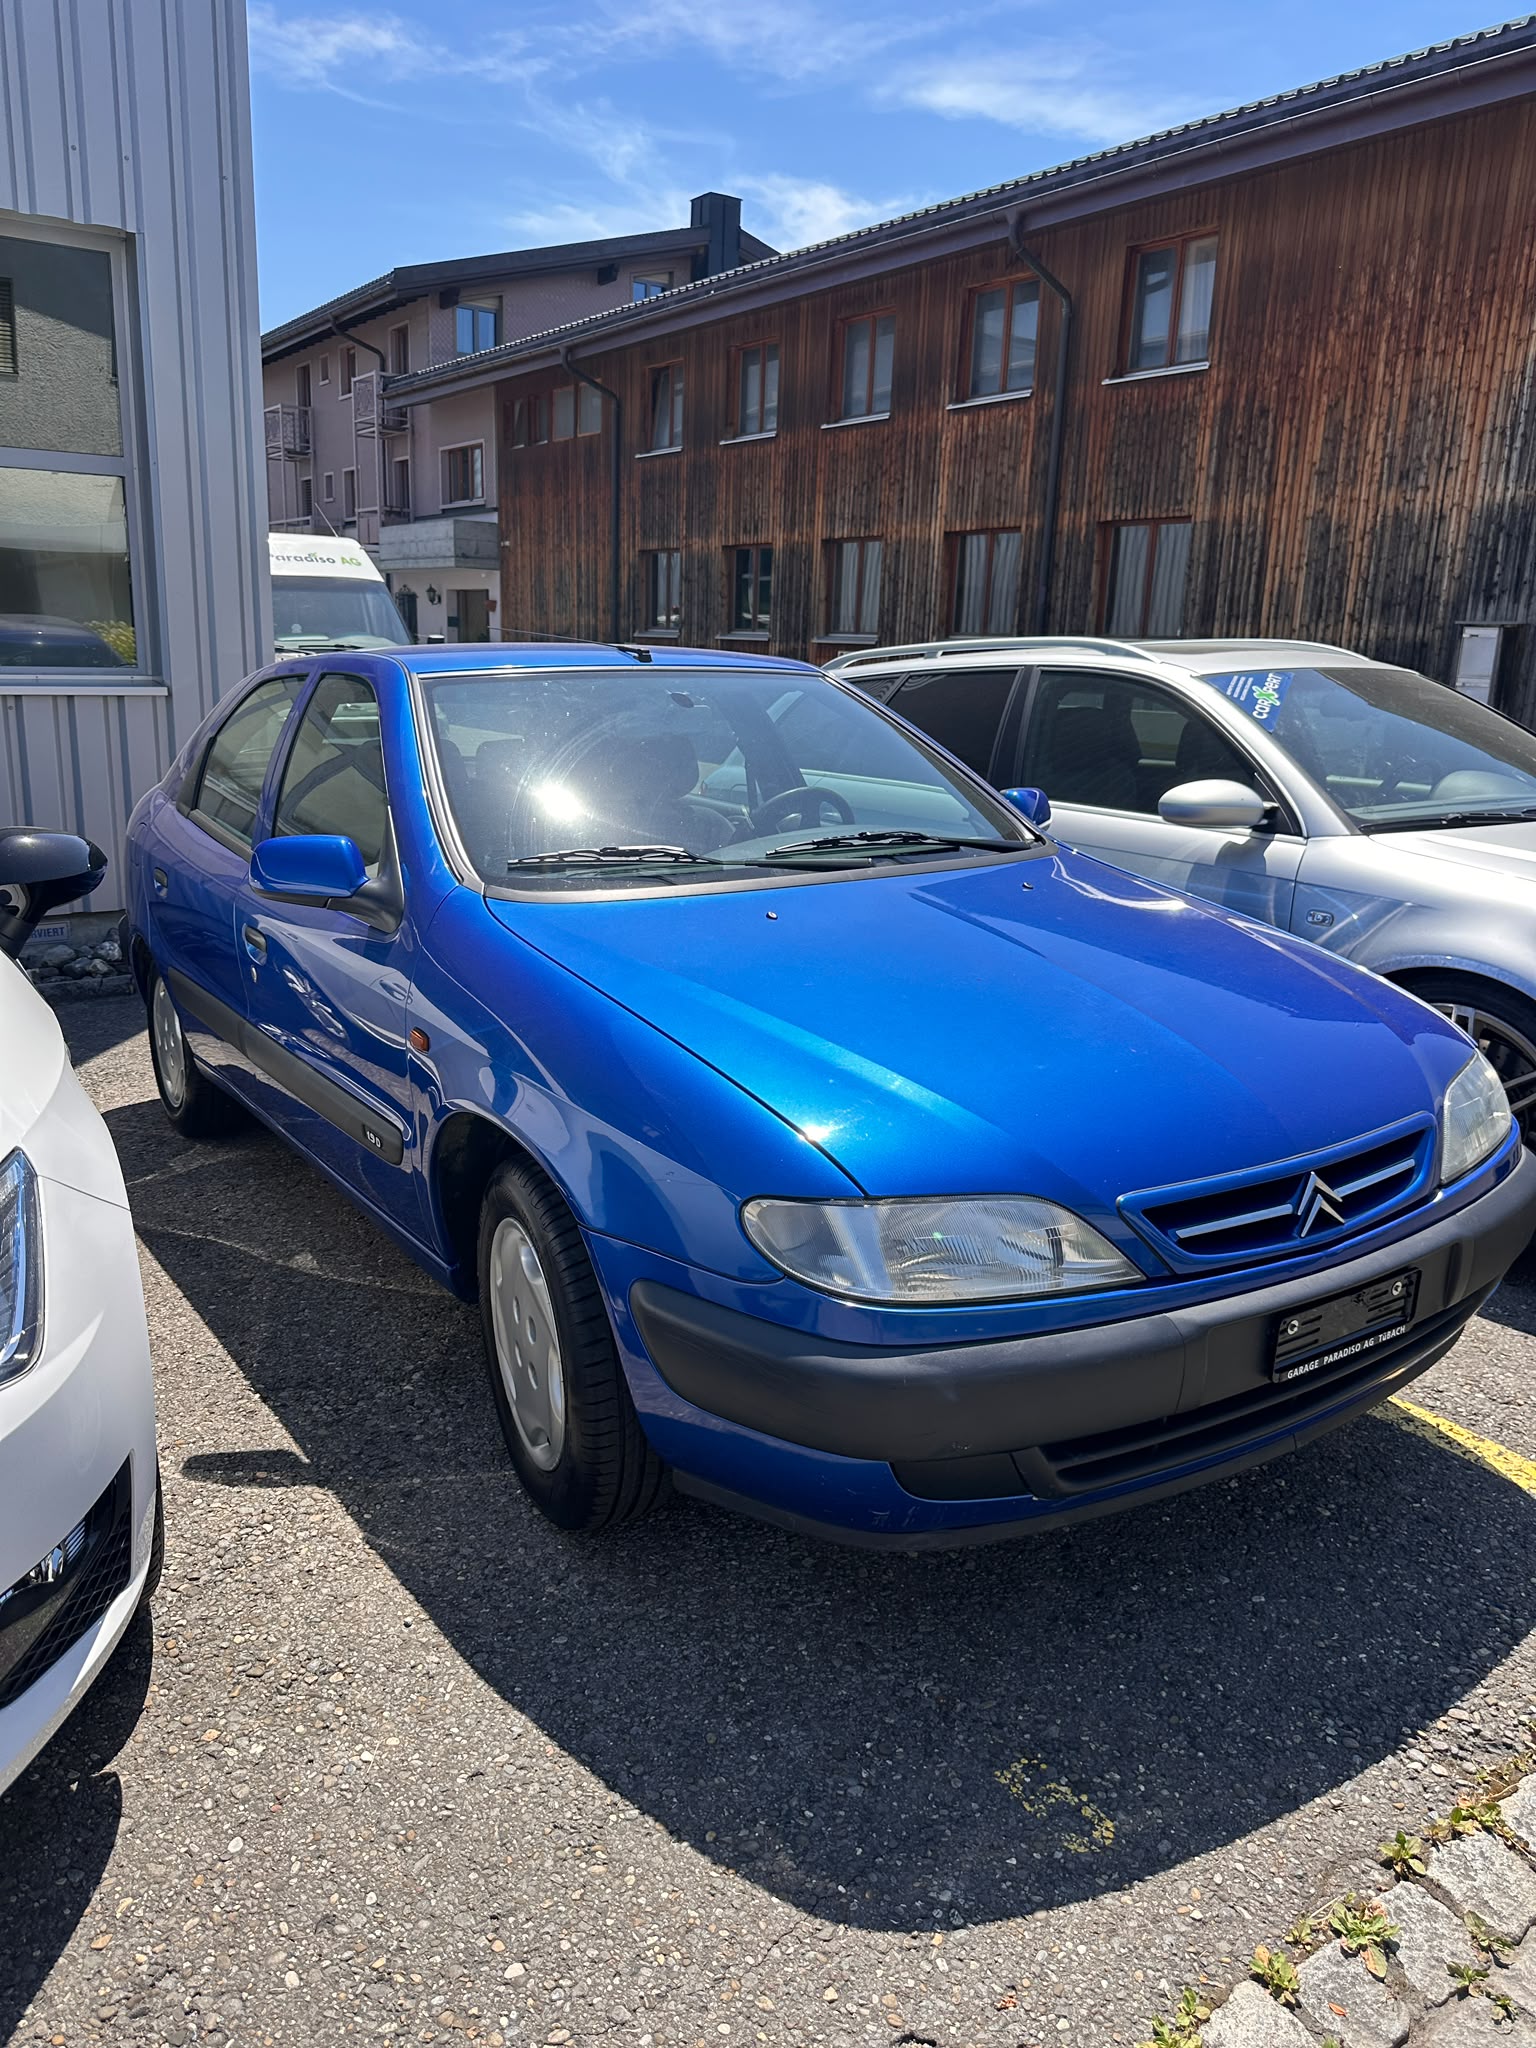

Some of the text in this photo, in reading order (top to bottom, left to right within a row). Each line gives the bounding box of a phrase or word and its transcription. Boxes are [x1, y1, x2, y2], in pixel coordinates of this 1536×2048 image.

[271, 552, 362, 567] aradiso AG
[32, 927, 65, 939] RVIERT
[1287, 1360, 1319, 1379] GARAGE
[1323, 1343, 1361, 1365] PARADISO
[1363, 1337, 1375, 1349] AG
